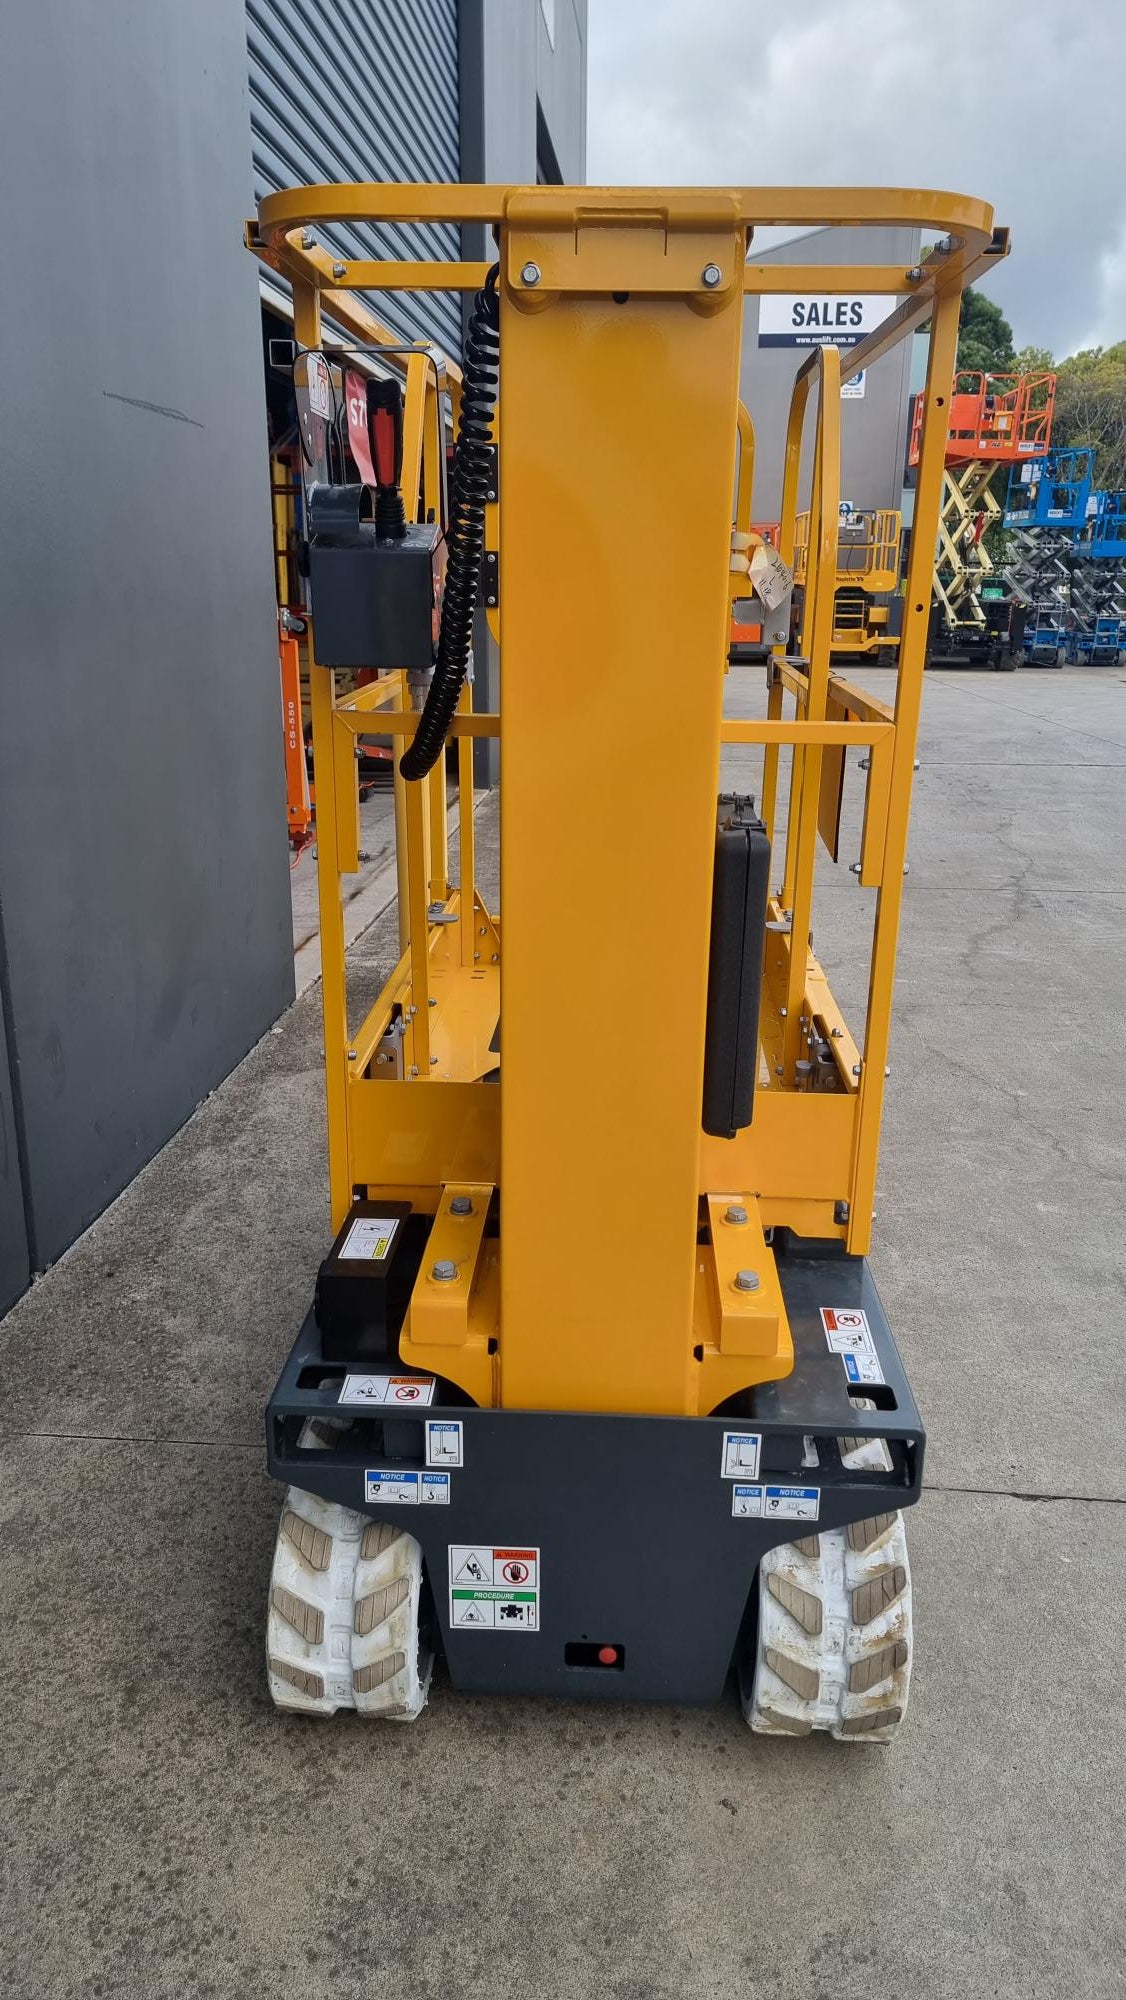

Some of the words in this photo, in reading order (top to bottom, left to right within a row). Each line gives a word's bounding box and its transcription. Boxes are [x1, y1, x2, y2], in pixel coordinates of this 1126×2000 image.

[792, 302, 863, 326] SALES
[350, 397, 368, 427] ST
[380, 1473, 405, 1481] NOTICE
[423, 1475, 446, 1483] NOTICE
[779, 1489, 805, 1497] NOTICE
[473, 1592, 515, 1600] PROCEDURE
